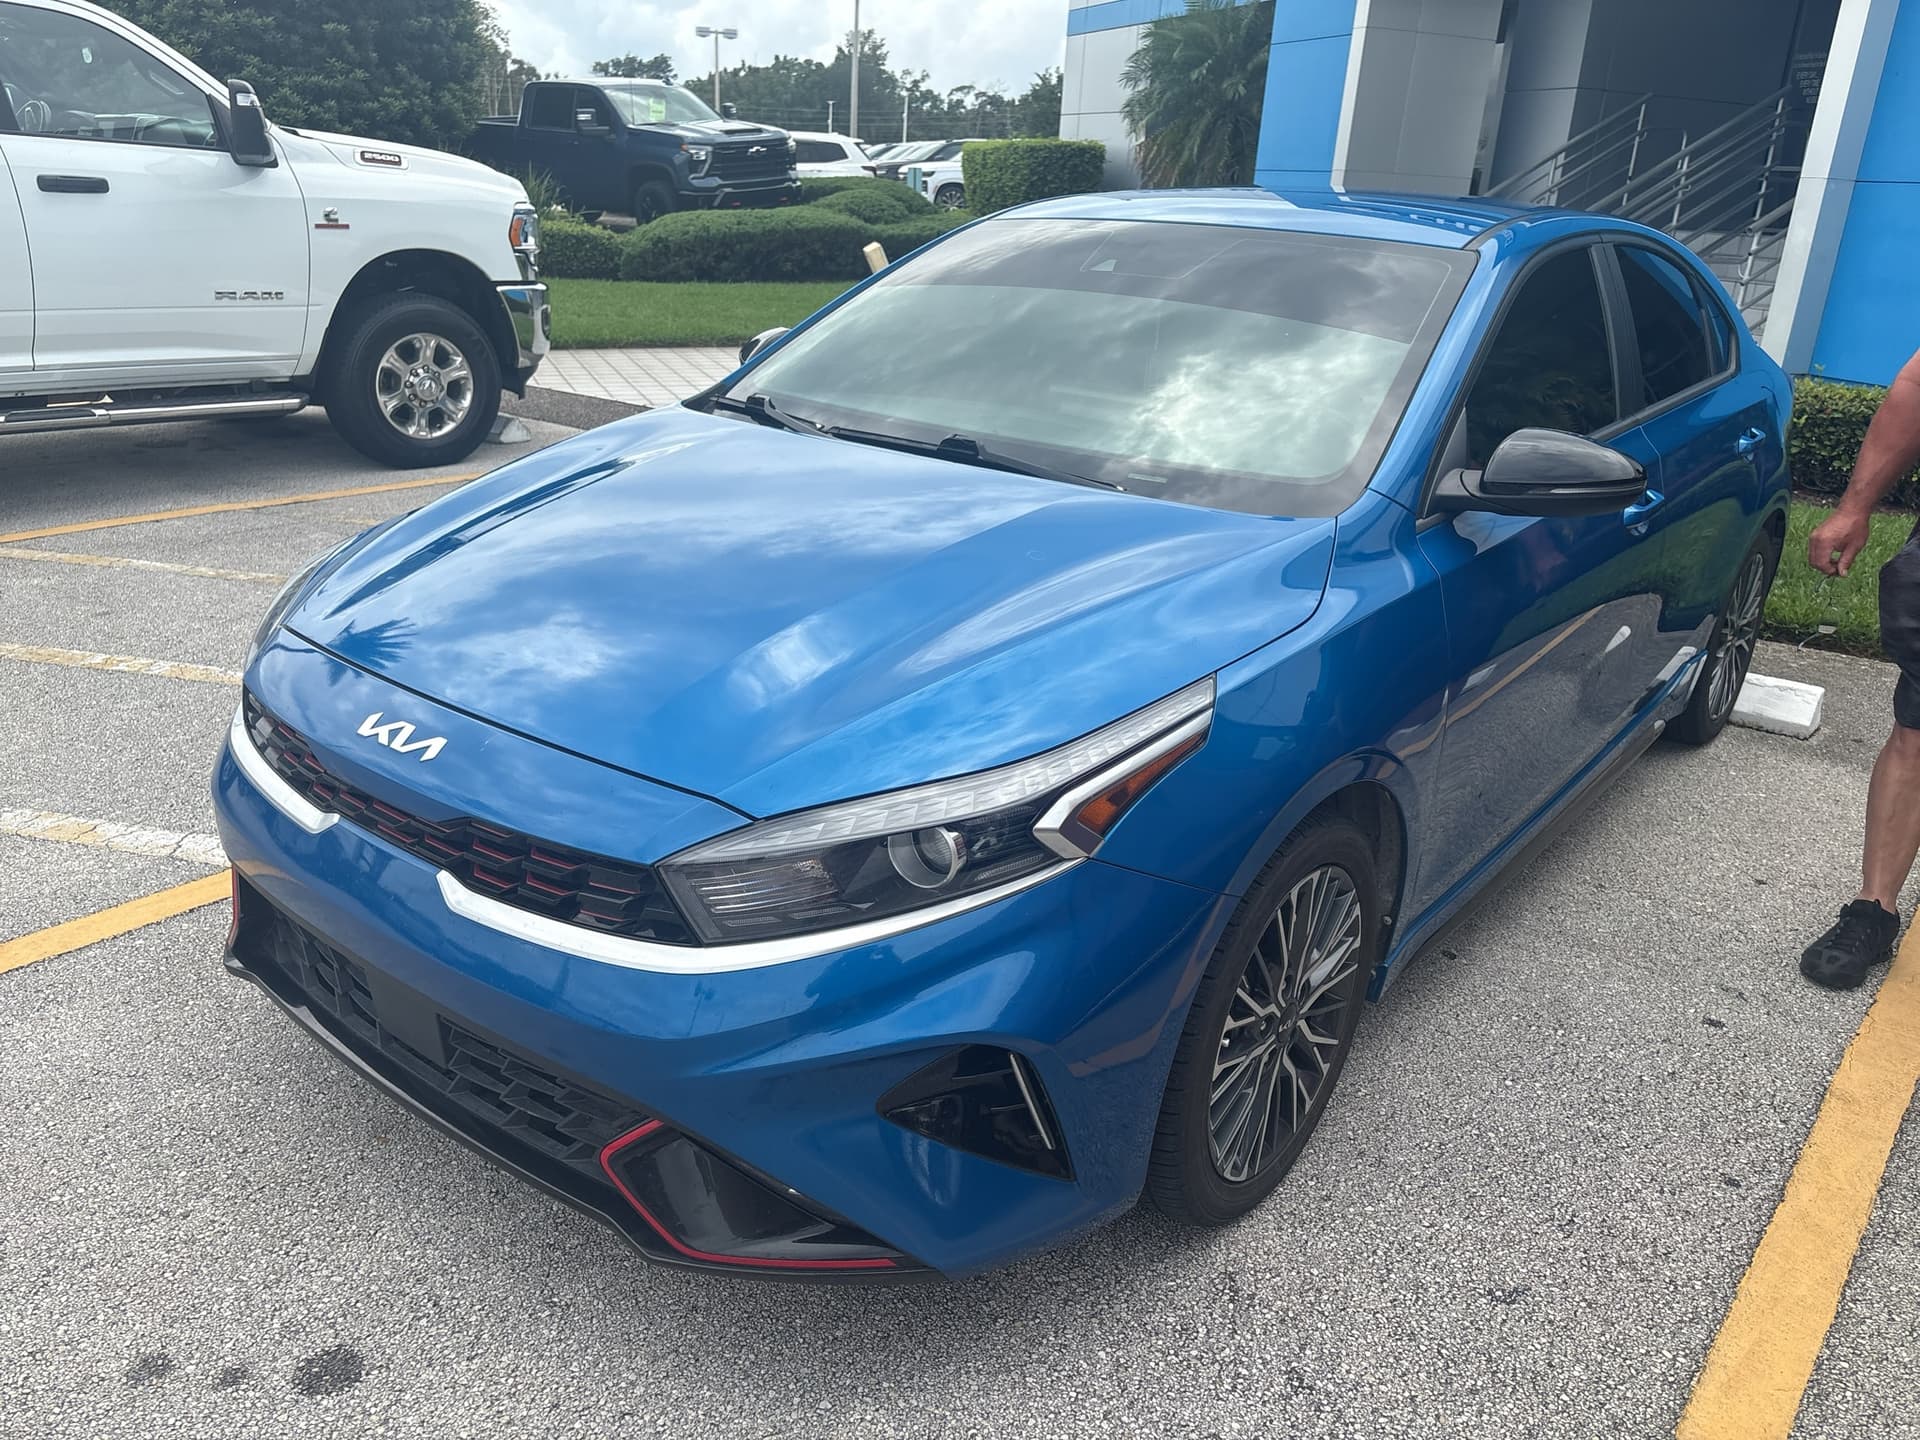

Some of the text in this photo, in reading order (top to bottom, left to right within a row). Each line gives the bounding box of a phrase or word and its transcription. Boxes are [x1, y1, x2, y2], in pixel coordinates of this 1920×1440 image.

[364, 152, 400, 162] 2500
[215, 289, 284, 301] RAM
[357, 712, 448, 762] KIA
